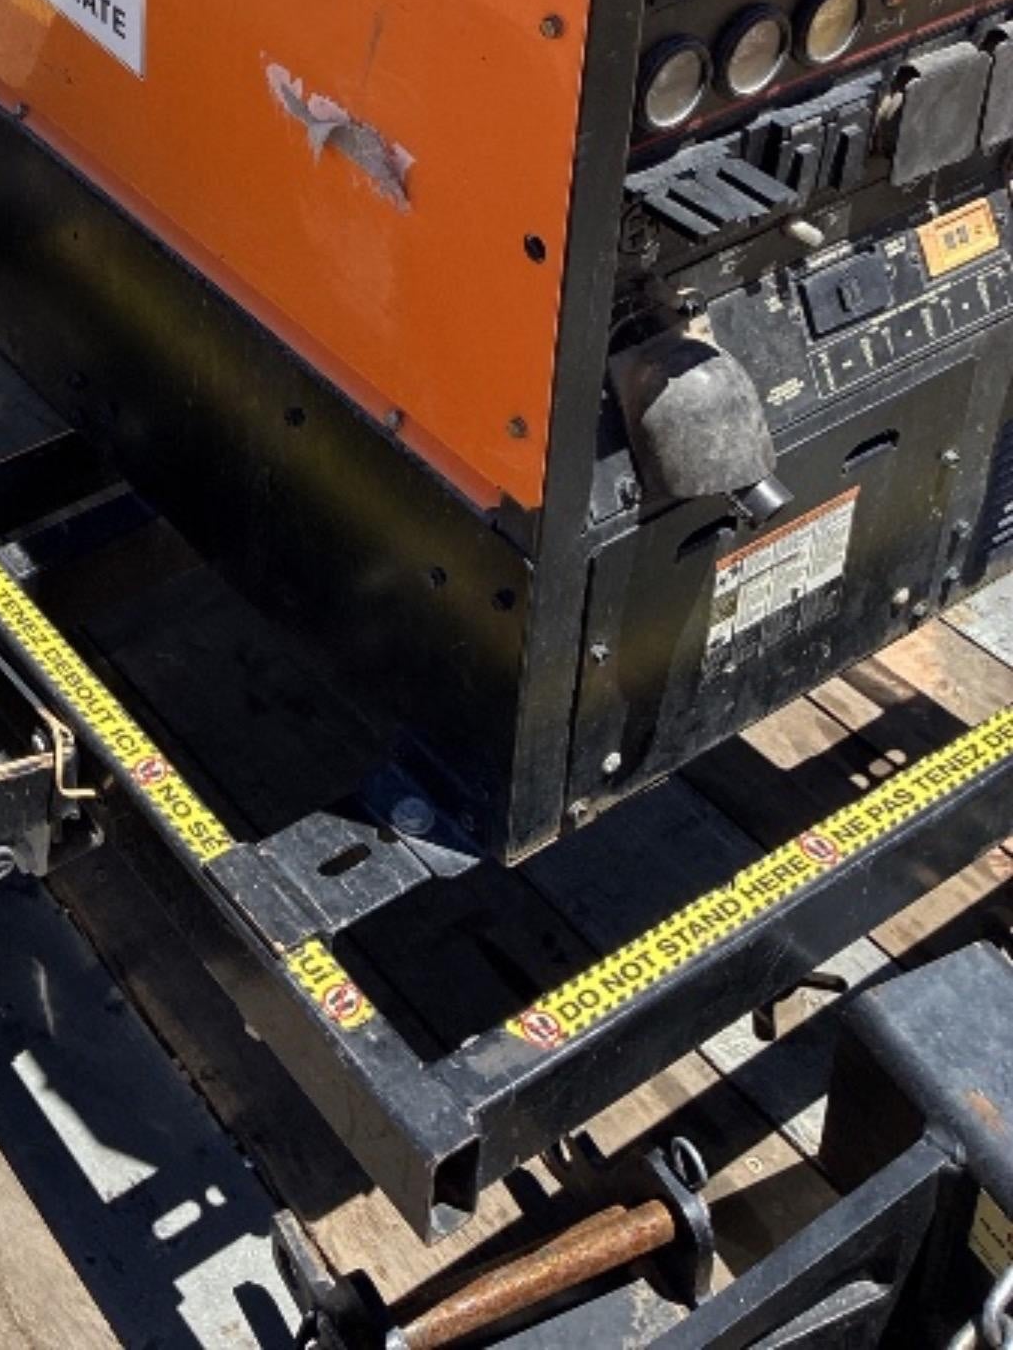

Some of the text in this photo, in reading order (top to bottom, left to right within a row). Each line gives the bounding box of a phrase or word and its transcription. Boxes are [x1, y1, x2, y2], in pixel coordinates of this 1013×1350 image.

[43, 646, 118, 725] DEBOUT
[109, 727, 141, 757] ICI
[157, 782, 192, 819] NO
[829, 815, 871, 845] NE
[864, 787, 916, 823] PAS
[910, 742, 988, 793] TENEZ
[557, 853, 811, 1022] DO NOT STAND HERE
